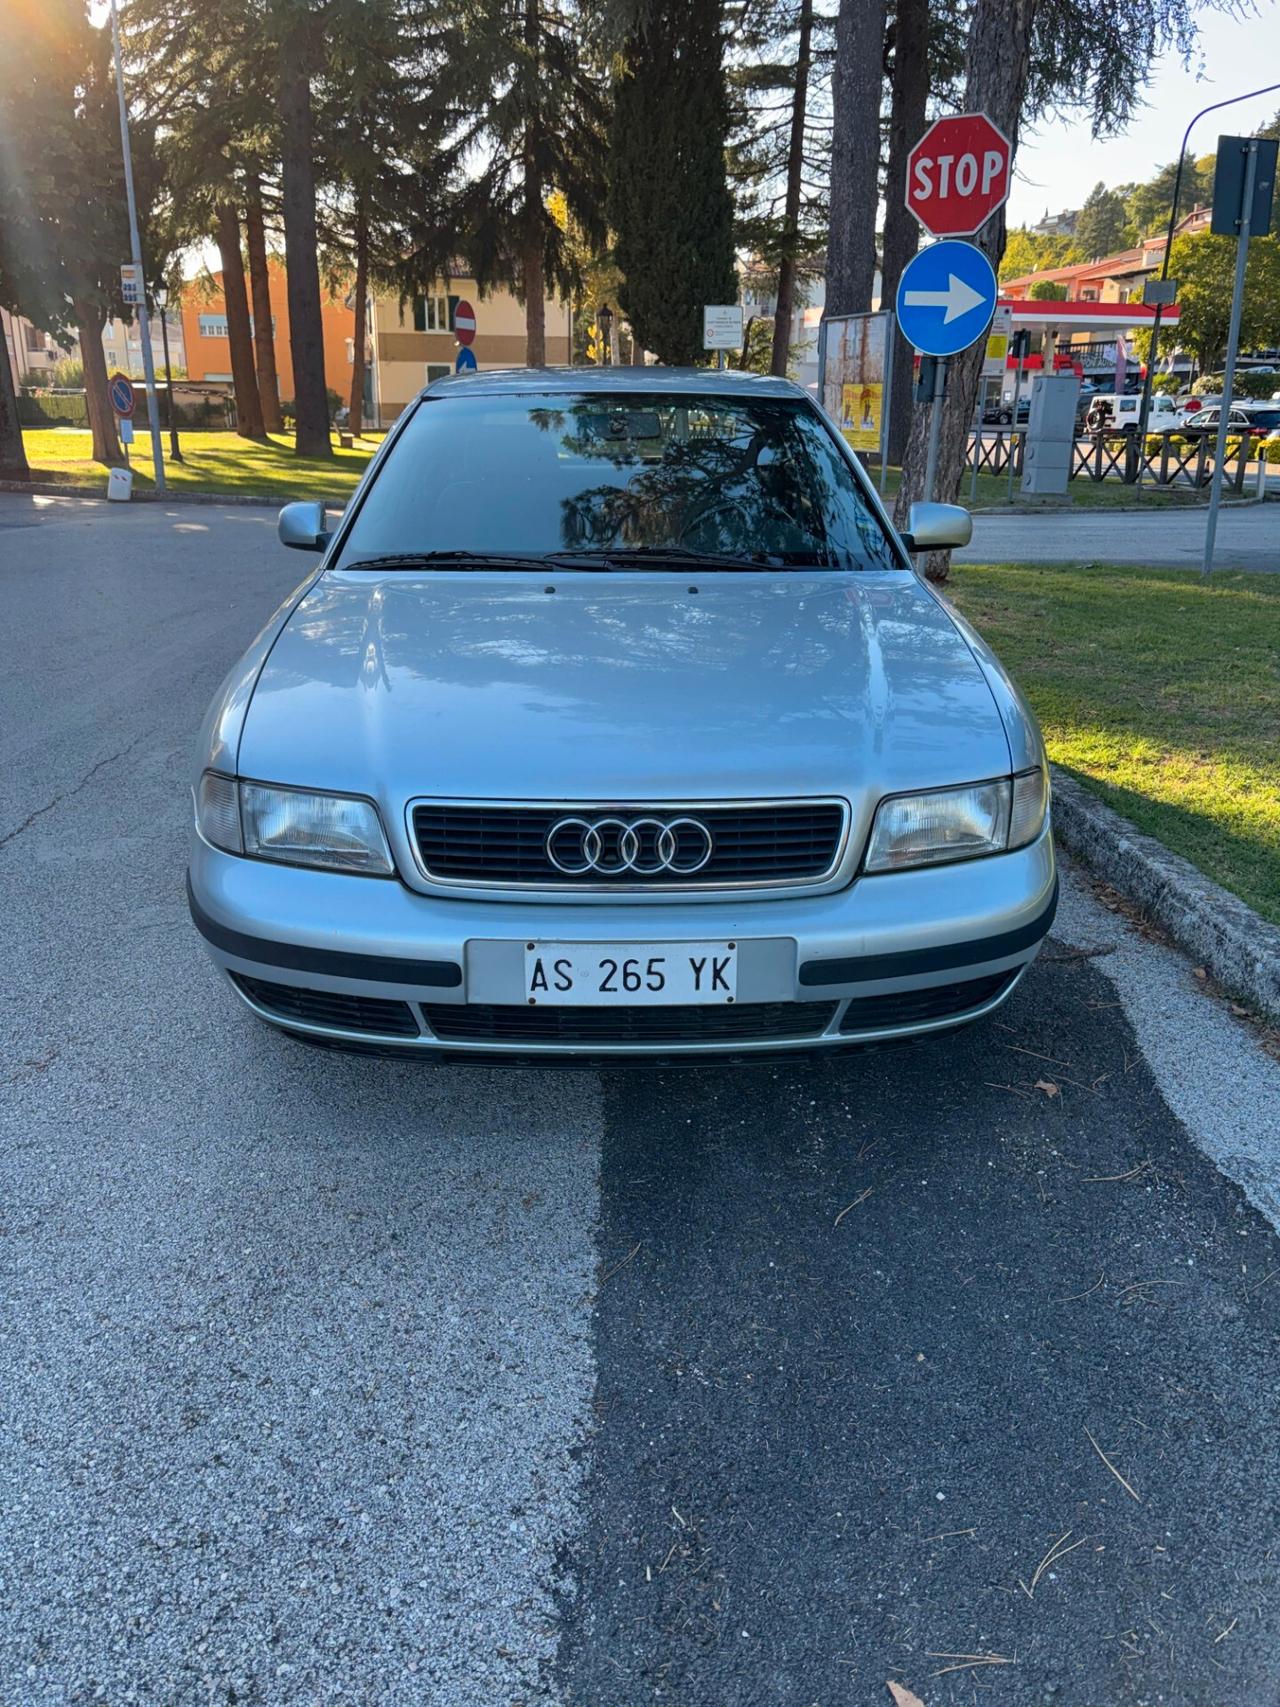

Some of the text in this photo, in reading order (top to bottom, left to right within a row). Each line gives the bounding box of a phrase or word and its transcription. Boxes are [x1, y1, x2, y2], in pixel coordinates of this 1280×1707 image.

[913, 150, 1003, 200] STOP
[530, 956, 731, 992] AS 265 YK
